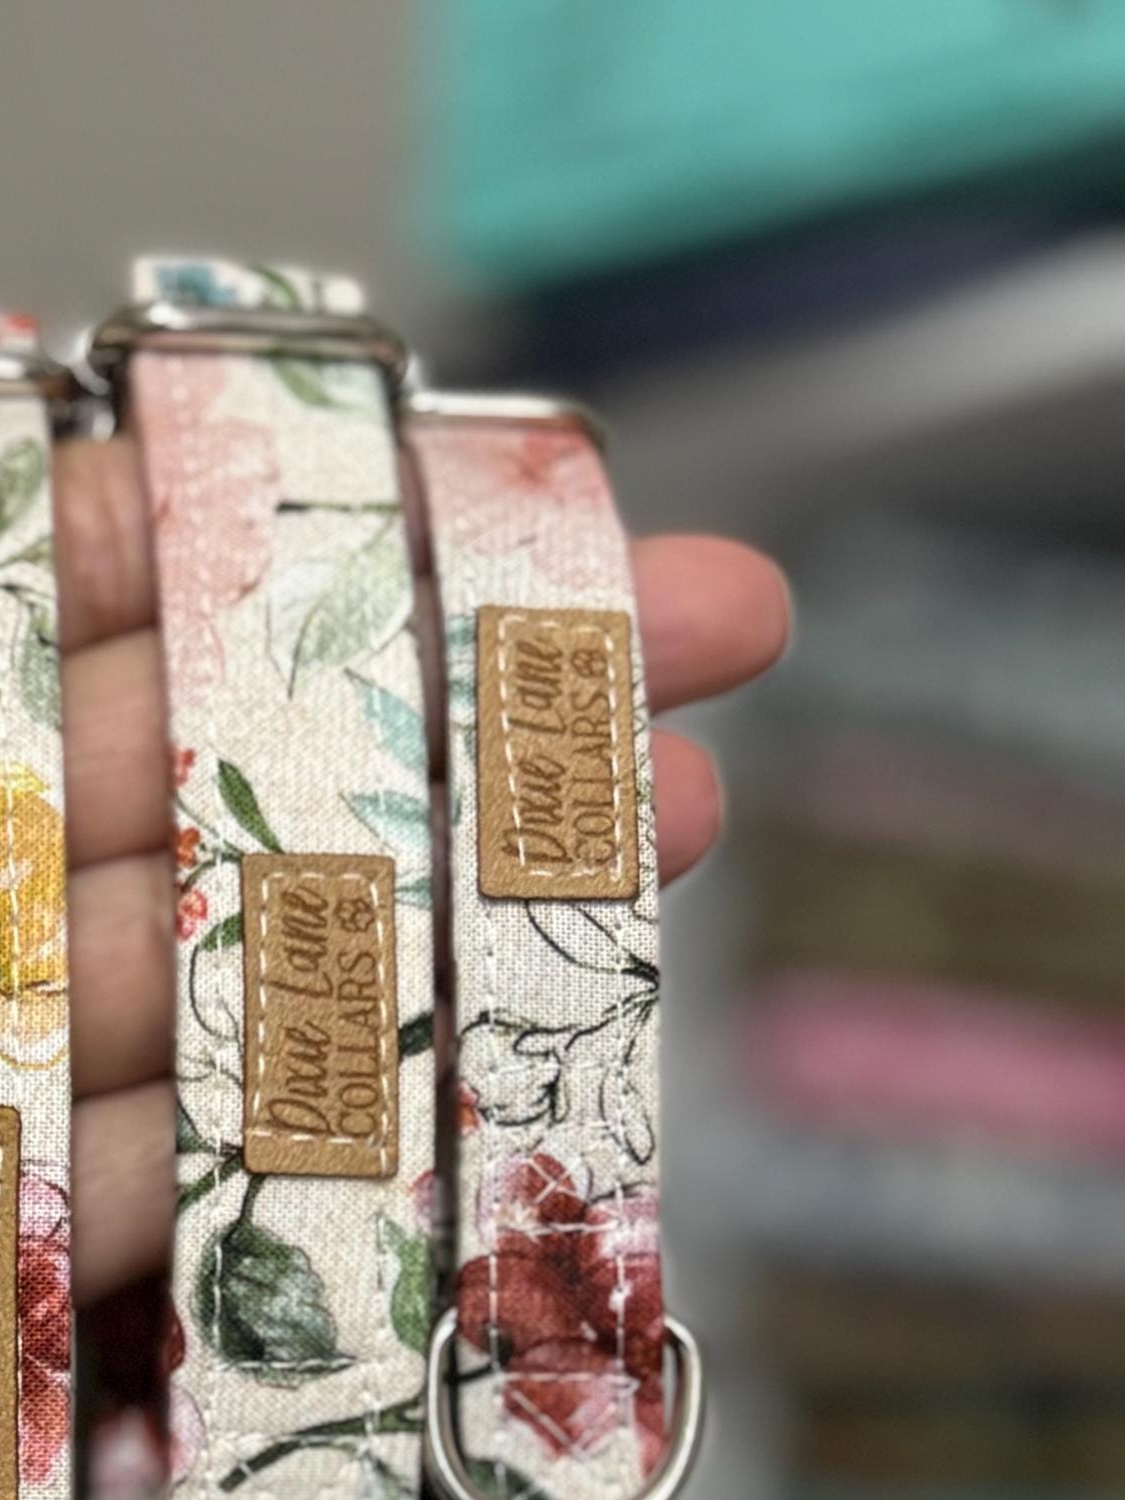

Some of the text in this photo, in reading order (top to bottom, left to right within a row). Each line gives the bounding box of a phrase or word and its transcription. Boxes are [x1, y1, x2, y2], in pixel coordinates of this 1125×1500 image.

[508, 640, 567, 734] Lane
[571, 694, 616, 865] COLLARS
[265, 885, 336, 1136] Dixie Lane
[337, 951, 379, 1137] COLLARS
